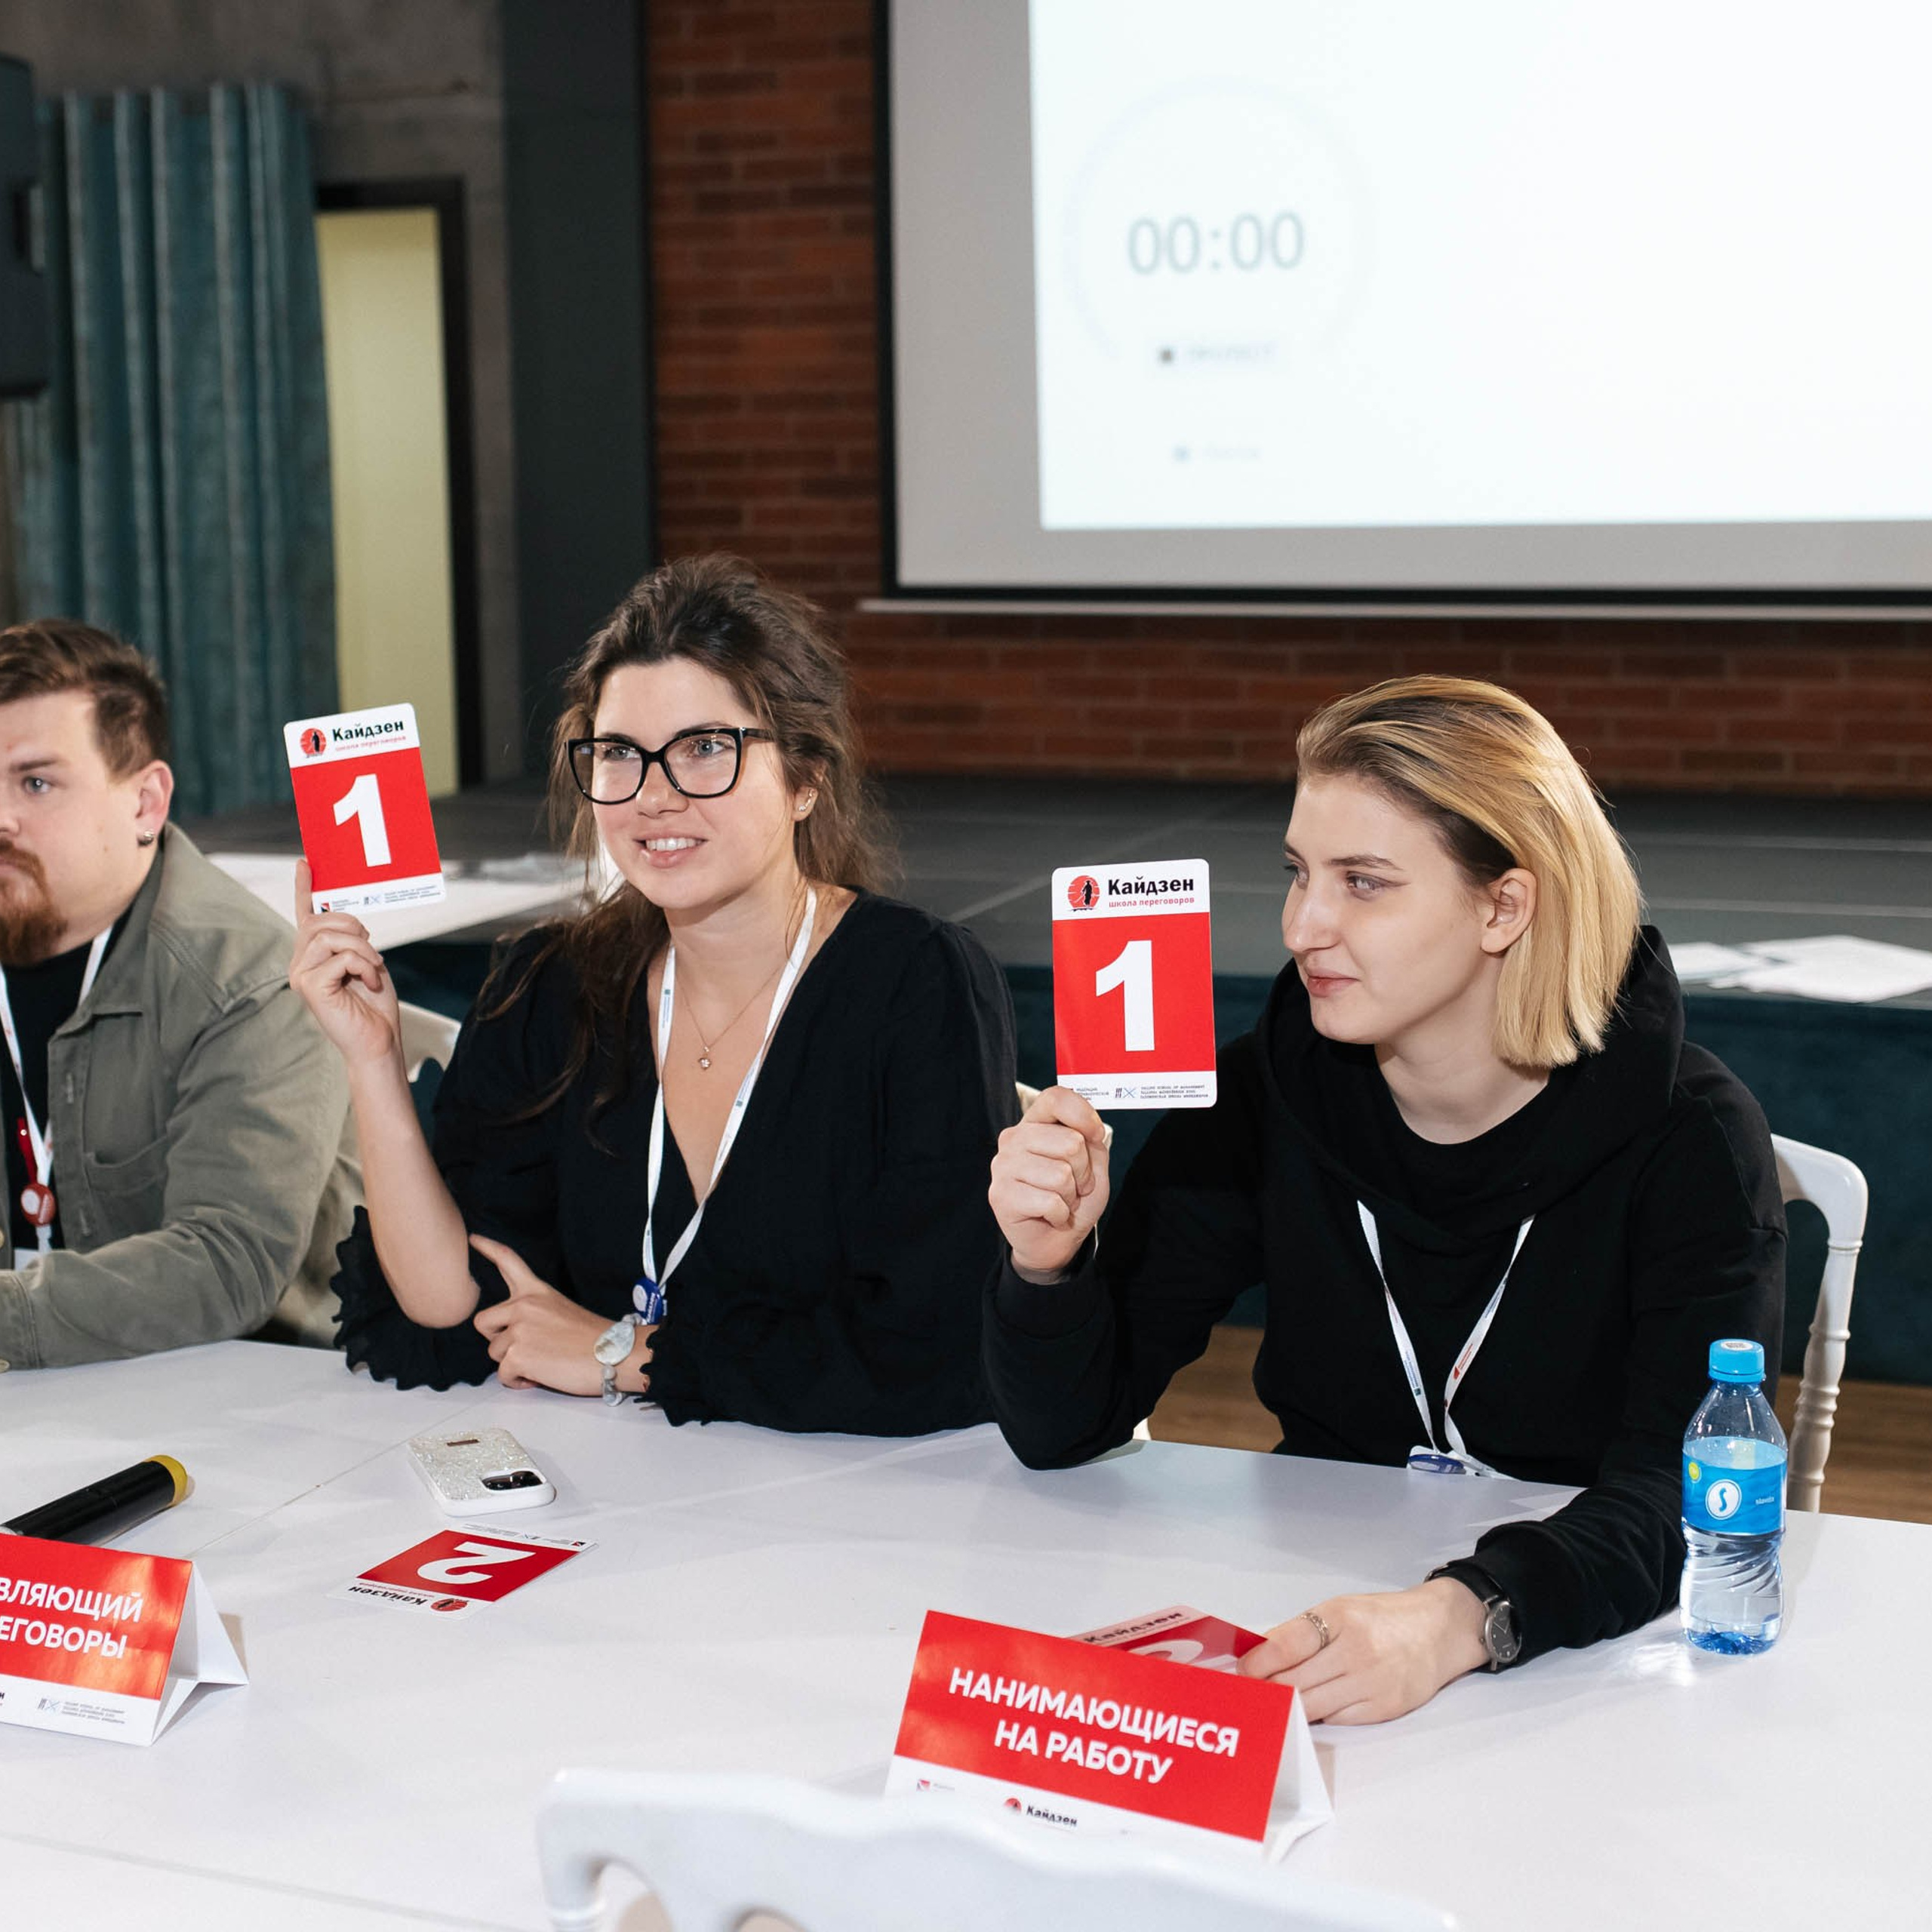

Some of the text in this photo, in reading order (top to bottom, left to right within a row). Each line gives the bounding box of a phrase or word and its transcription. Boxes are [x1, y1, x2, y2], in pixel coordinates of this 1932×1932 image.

[1128, 211, 1304, 274] 00:00
[332, 720, 405, 742] Кайдзен
[333, 774, 392, 867] 1
[1108, 875, 1194, 896] Кайдзен
[1109, 897, 1195, 908] школа переговоров
[1096, 940, 1155, 1051] 1
[417, 1541, 537, 1584] 2
[0, 1577, 144, 1623] ВЛЯЮЩИЙ
[349, 1586, 428, 1605] Кайдзен
[0, 1615, 128, 1659] ЕГОВОРЫ
[1084, 1613, 1183, 1642] Кайдзен
[949, 1666, 1240, 1758] НАНИМАЮЩИЕСЯ
[994, 1720, 1174, 1785] НА РАБОТУ
[1026, 1804, 1078, 1827] Кайдзен
